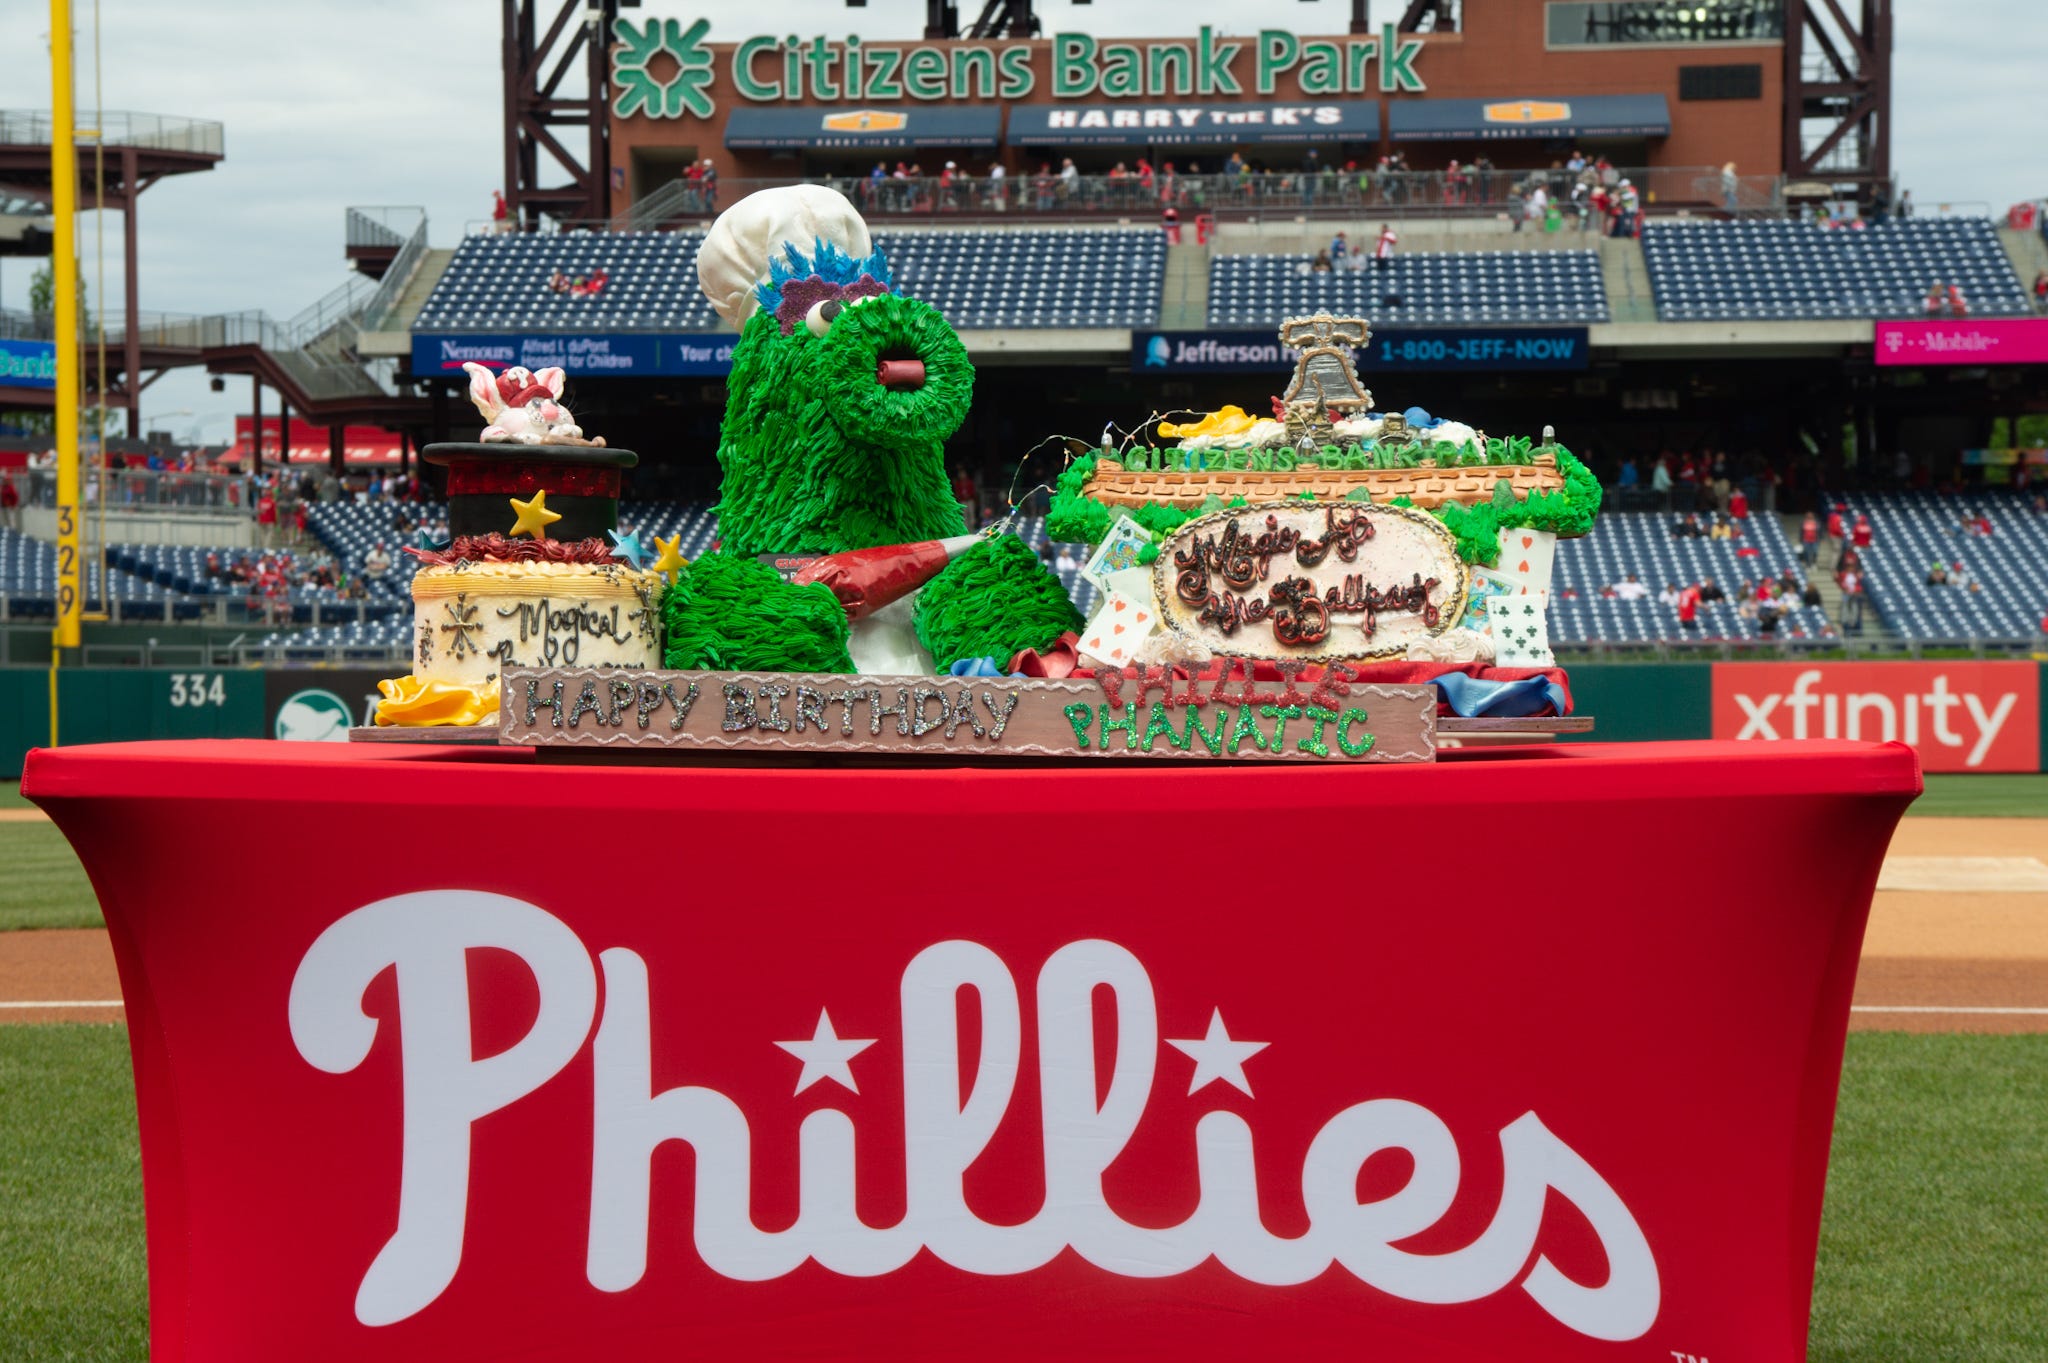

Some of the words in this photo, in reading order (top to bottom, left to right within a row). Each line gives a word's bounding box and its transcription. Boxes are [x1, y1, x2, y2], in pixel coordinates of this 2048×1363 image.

[732, 32, 1037, 101] Citizens
[1051, 25, 1243, 98] Bank
[1256, 22, 1427, 93] Park
[1049, 109, 1203, 128] HARRY
[1210, 111, 1265, 124] THE
[1272, 107, 1342, 125] K'S
[441, 341, 514, 360] Nemours
[521, 339, 556, 354] Alfred
[569, 339, 609, 354] duPont
[521, 354, 566, 369] Hospital
[569, 354, 583, 367] for
[586, 354, 632, 368] Children
[681, 345, 713, 361] Your
[1176, 341, 1277, 363] Jefferson
[1381, 339, 1575, 361] 1-800-JEFF-NOW
[1124, 446, 1297, 473] CITIZENS
[1323, 443, 1421, 471] BANK
[1435, 436, 1533, 468] PARK
[496, 597, 632, 664] Magical
[170, 674, 226, 706] 334
[1099, 659, 1360, 711] PHILLIE
[525, 679, 700, 729] HAPPY
[721, 683, 1020, 740] BIRTHDAY
[1734, 671, 2019, 767] xfinity
[1063, 702, 1376, 757] PHANATIC
[287, 889, 1661, 1341] Phillies
